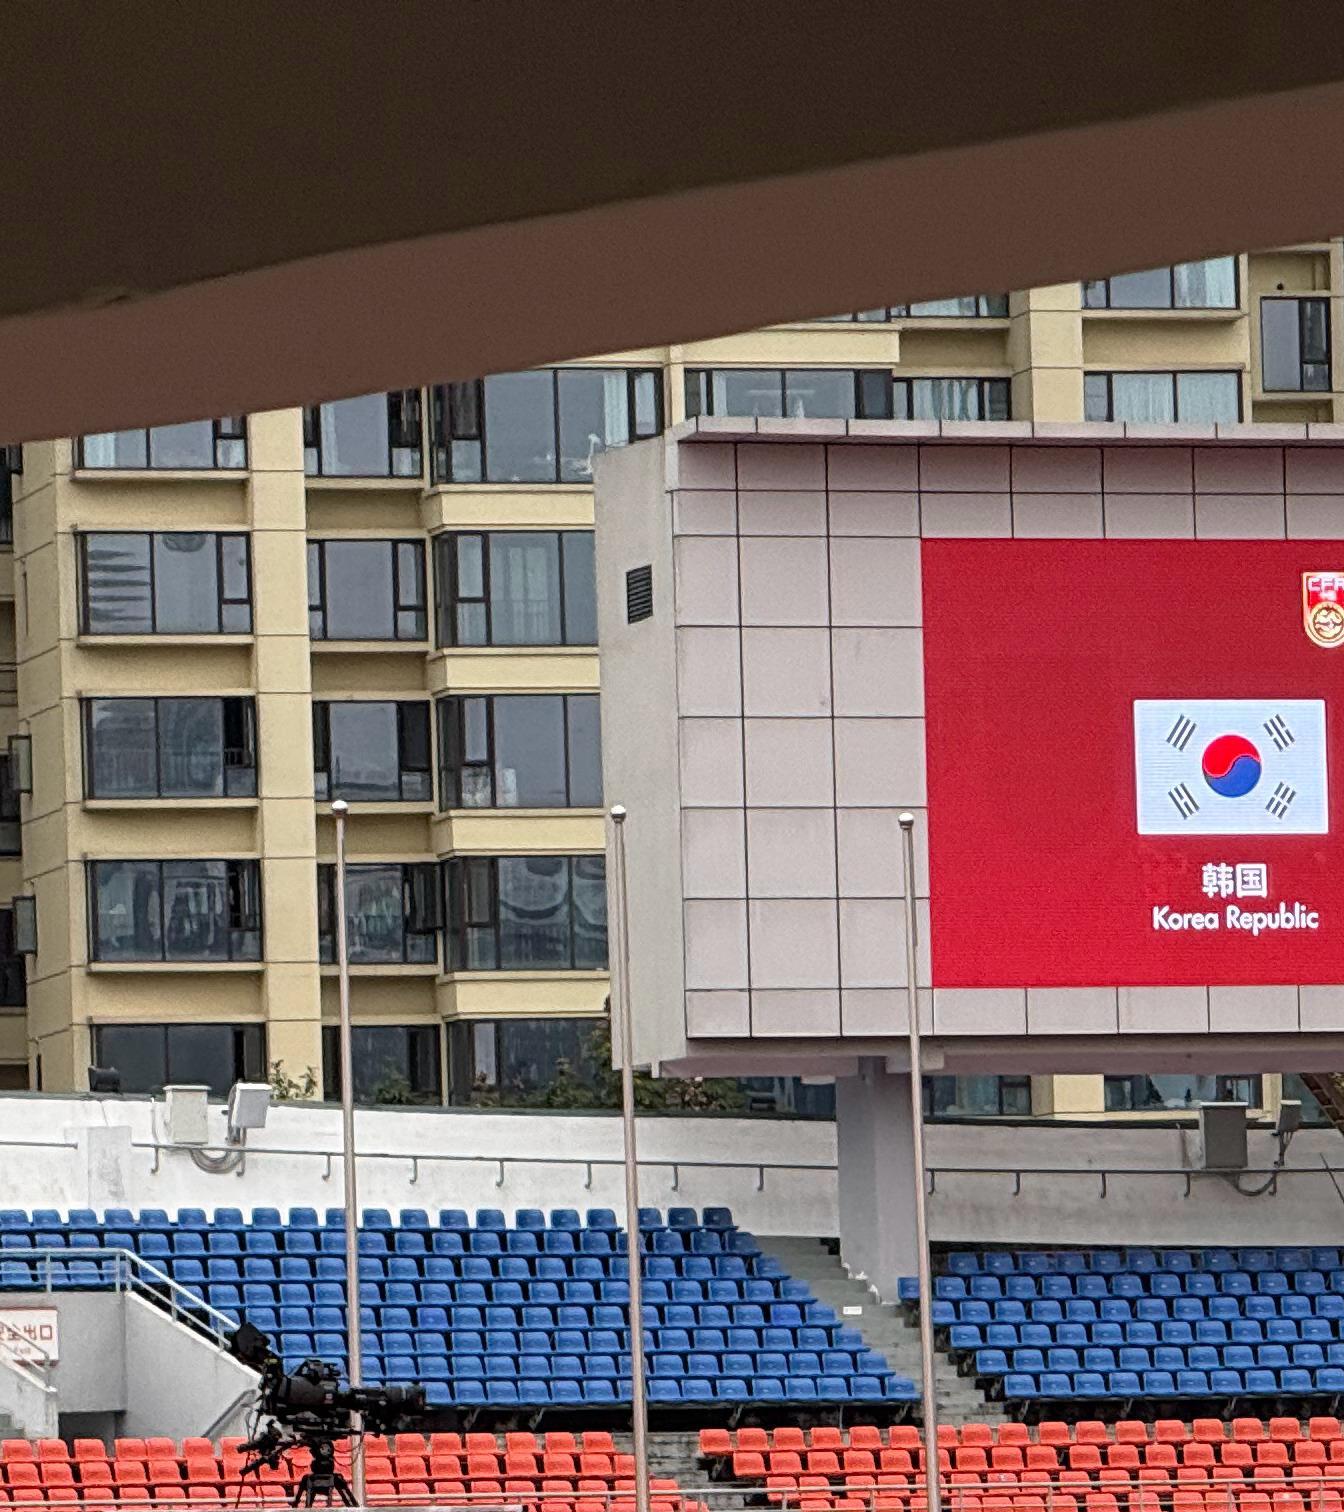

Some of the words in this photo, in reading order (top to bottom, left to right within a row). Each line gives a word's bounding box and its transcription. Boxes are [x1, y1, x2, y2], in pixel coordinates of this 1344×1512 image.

[1202, 862, 1268, 899] 韩国
[1152, 905, 1219, 930] Korea
[1226, 901, 1319, 936] Republic
